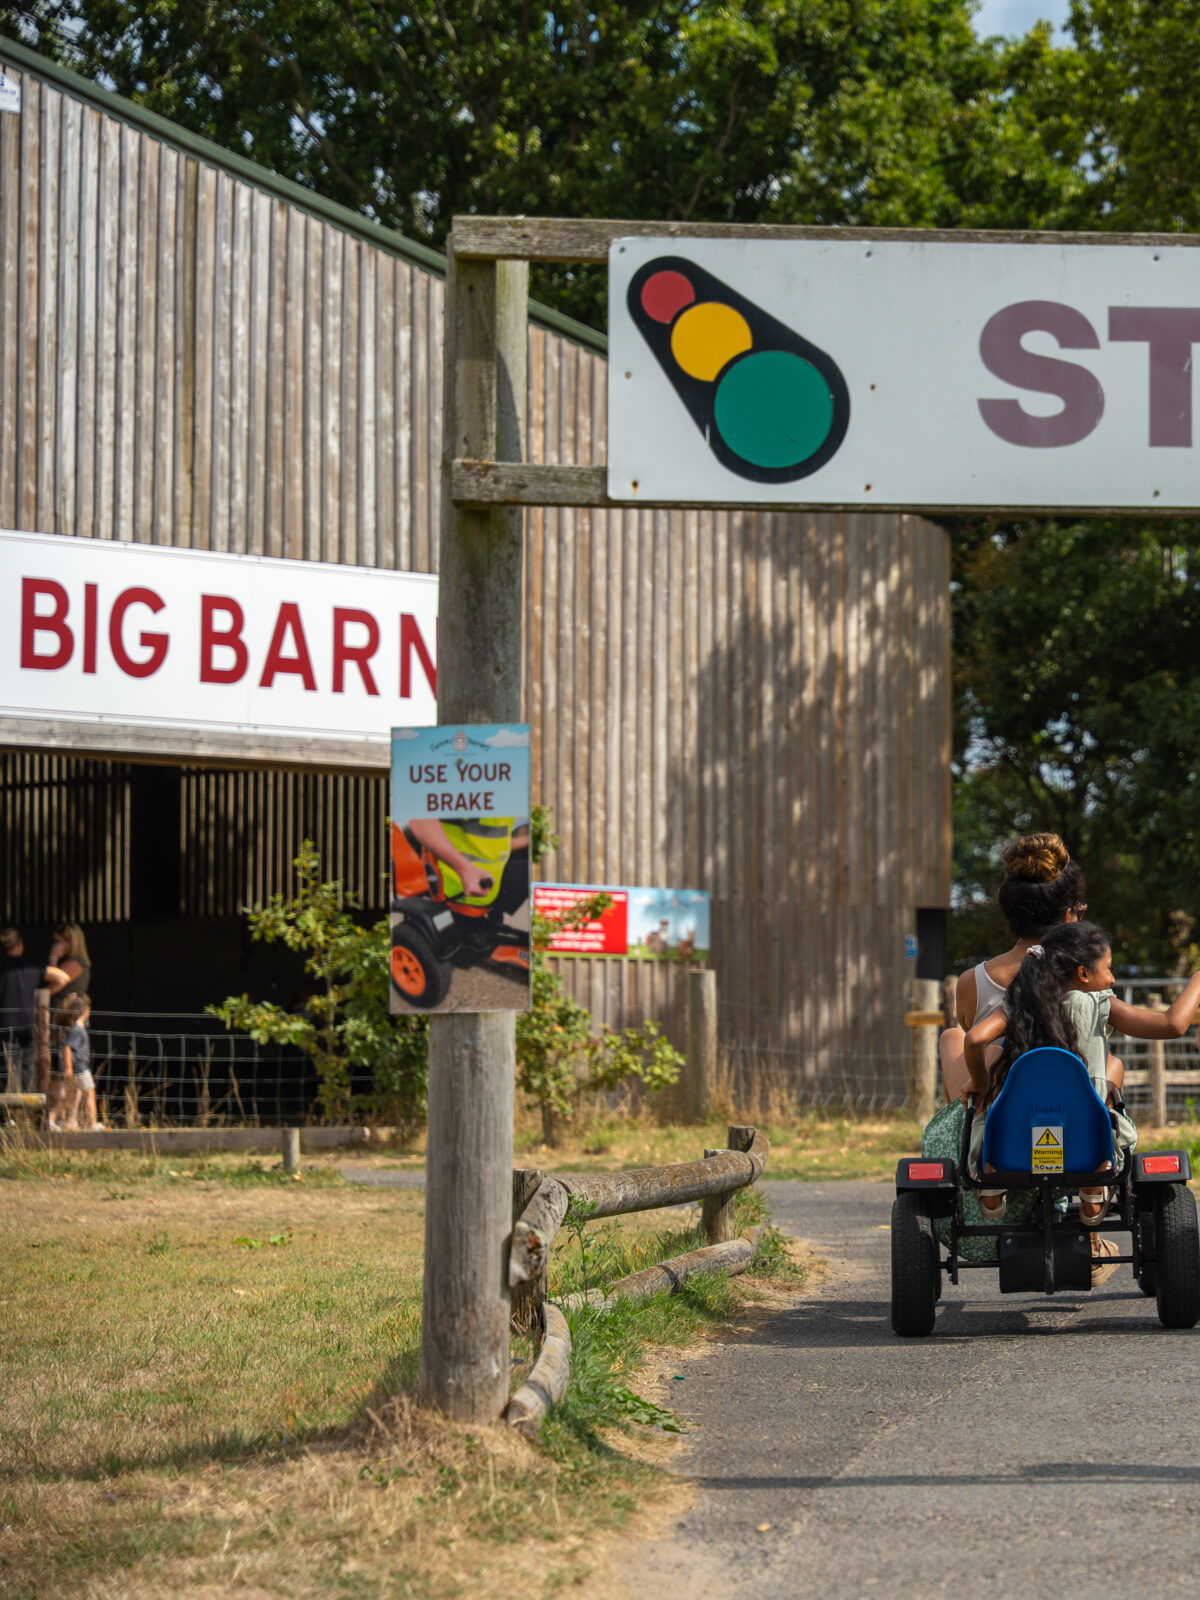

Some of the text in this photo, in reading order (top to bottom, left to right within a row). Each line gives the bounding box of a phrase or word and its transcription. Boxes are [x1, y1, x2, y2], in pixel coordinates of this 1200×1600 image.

[20, 577, 438, 699] BIG BARN
[409, 763, 511, 783] USE YOUR
[426, 791, 494, 811] BRAKE
